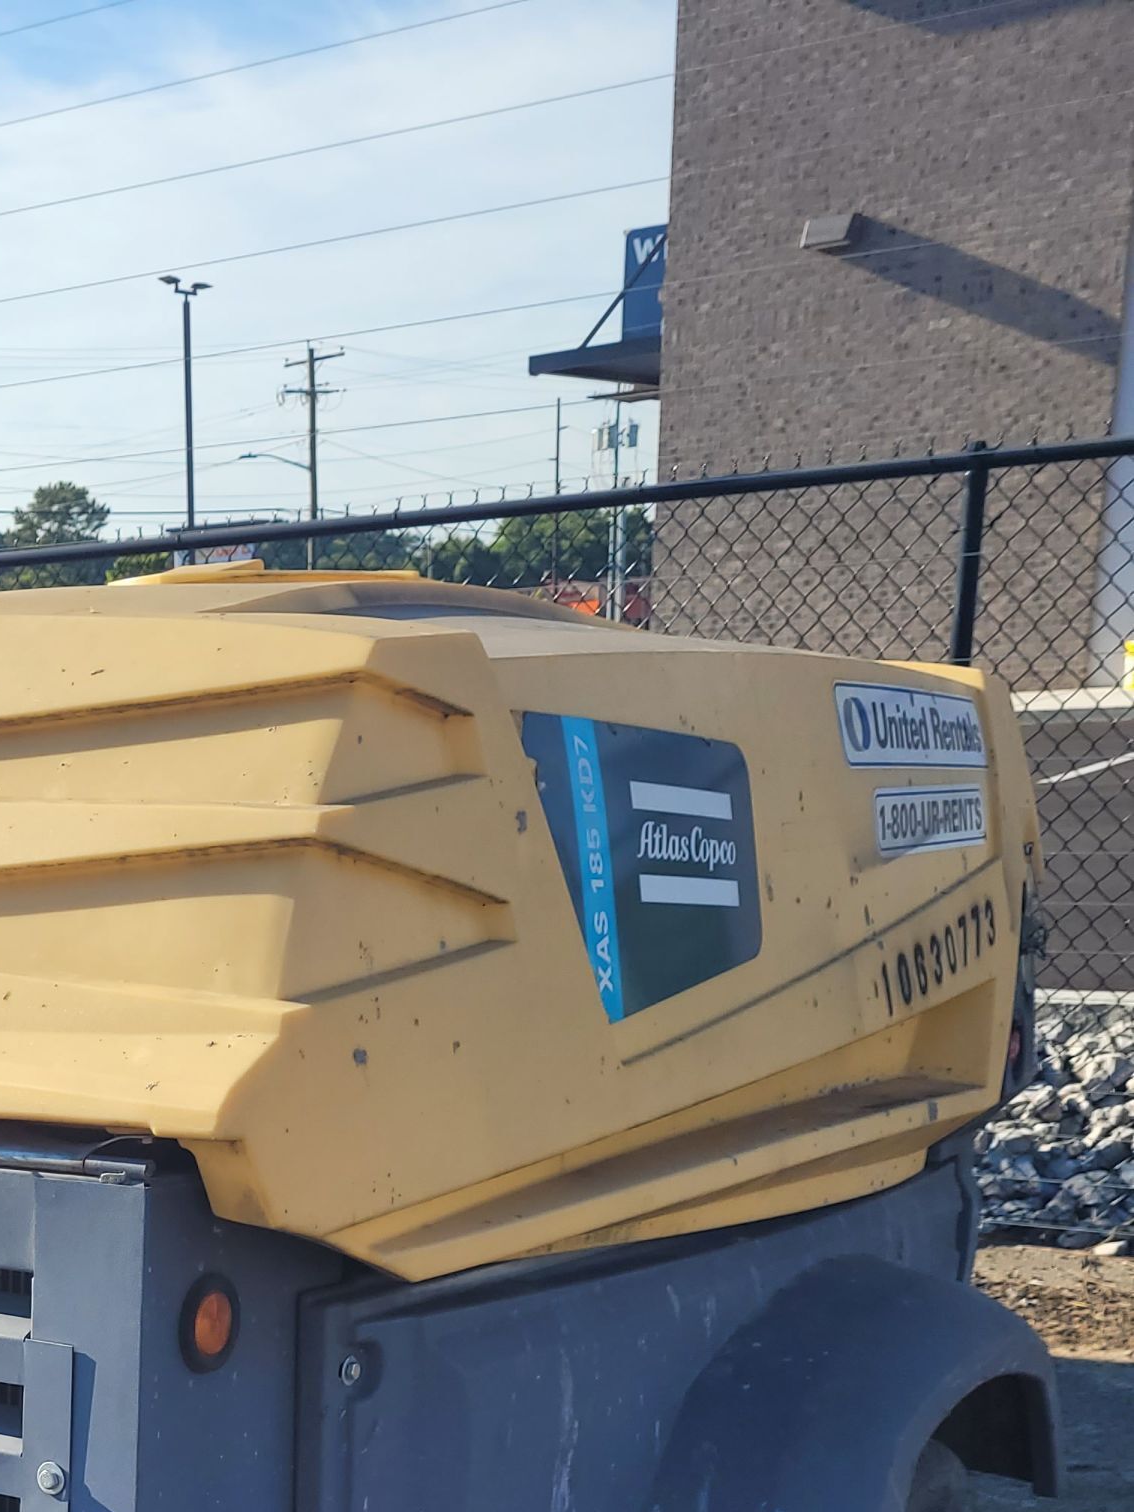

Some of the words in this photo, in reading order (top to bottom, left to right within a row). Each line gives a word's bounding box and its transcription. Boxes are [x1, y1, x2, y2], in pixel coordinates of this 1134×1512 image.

[633, 233, 668, 265] W
[872, 701, 930, 750] United
[929, 707, 982, 752] Rentals
[573, 735, 597, 812] KD7
[637, 821, 690, 862] Atlas
[690, 826, 736, 871] Copco
[879, 797, 983, 840] 1-800-UR-RENTS
[586, 828, 605, 893] 185
[593, 910, 614, 993] XAS
[881, 899, 996, 1016] 10630773
